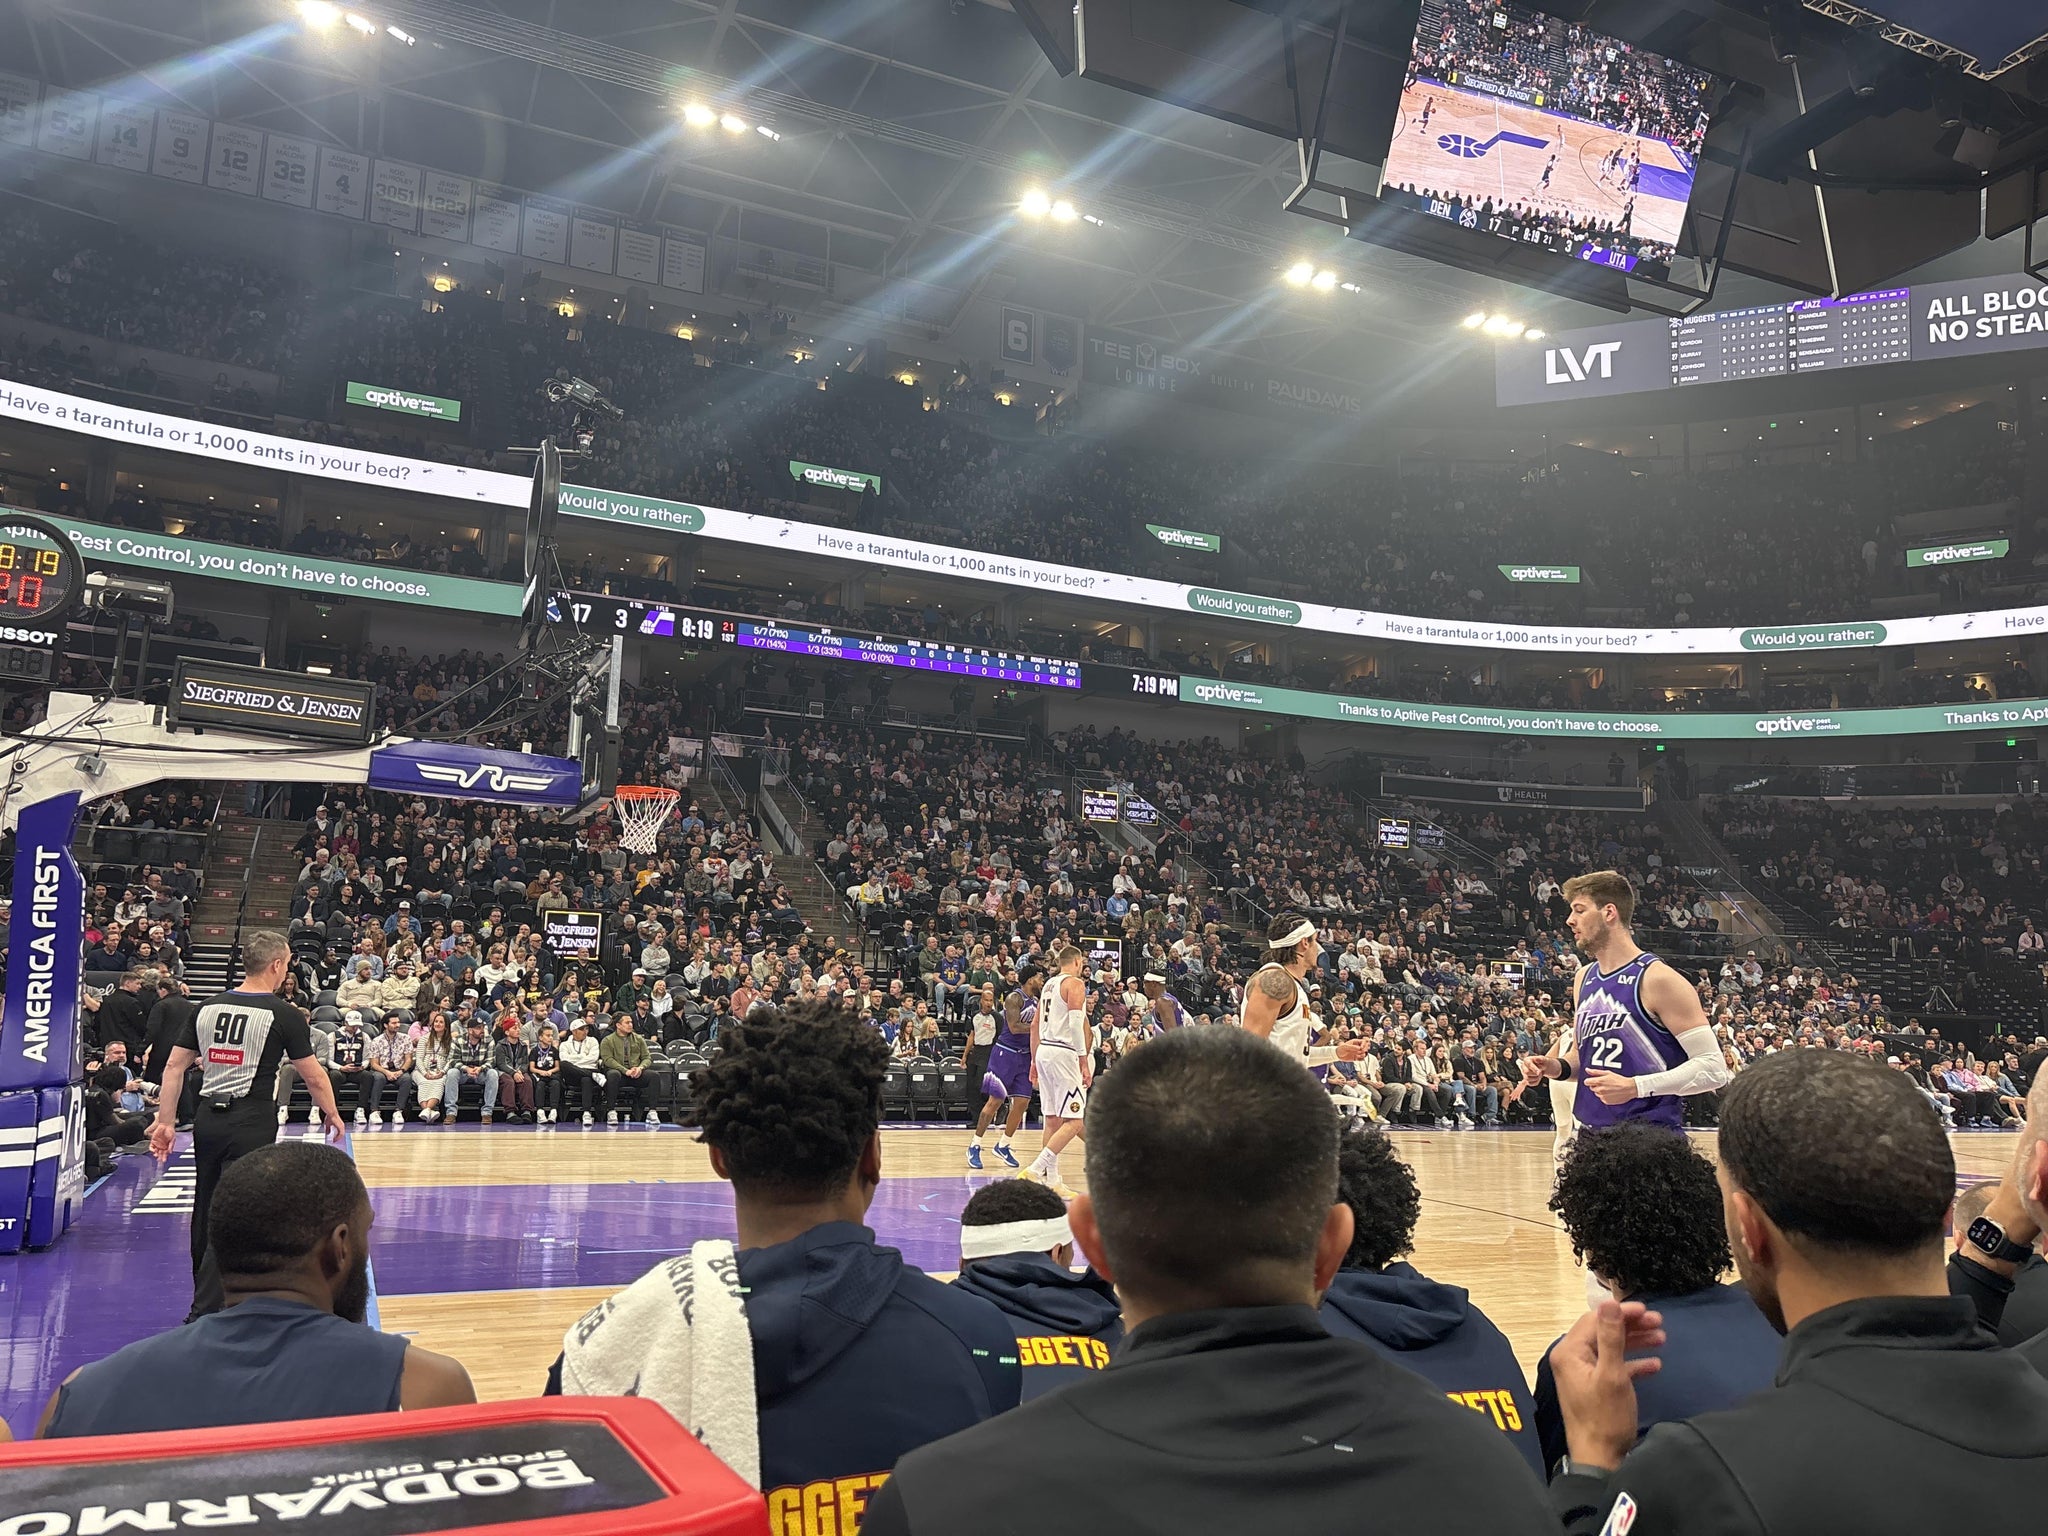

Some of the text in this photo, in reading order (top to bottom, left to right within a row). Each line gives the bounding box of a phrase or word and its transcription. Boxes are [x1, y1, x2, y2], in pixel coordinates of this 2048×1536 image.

[1463, 75, 1530, 101] SIEGFRIED & JENSEN
[51, 111, 87, 135] 53
[112, 124, 139, 148] 14
[172, 138, 190, 158] 9
[221, 148, 248, 171] 12
[273, 160, 306, 184] 32
[336, 175, 351, 194] 4
[427, 194, 468, 216] 1223
[1430, 200, 1627, 269] DEN 17 8:19 21 3 UTA
[1802, 300, 1821, 310] JAZZ
[1927, 297, 1977, 320] ALL
[1684, 313, 1716, 325] NUGGETS
[1929, 320, 1969, 343] NO
[1976, 310, 2048, 338] STEA
[1007, 319, 1029, 352] 6
[1090, 338, 1201, 376] TEE BOX
[1545, 341, 1622, 384] LVT
[1115, 367, 1177, 392] LOUNGE
[366, 390, 419, 410] aptive
[0, 389, 411, 480] Have a tarantula or 1,000 ants in your bed?
[804, 468, 847, 484] aptive
[558, 491, 692, 526] Would you rather:
[1158, 530, 1194, 544] aptive
[0, 543, 60, 576] 8:19
[69, 529, 431, 598] Pest Control, you don't have to choose.
[817, 533, 1095, 589] Have a tarantula or 1,000 ants in your bed?
[1923, 546, 1970, 564] aptive
[1511, 566, 1550, 581] aptive
[572, 603, 628, 628] 17 3
[1196, 593, 1293, 619] Would you rather:
[682, 616, 713, 640] 8:19
[722, 621, 735, 632] 21
[1386, 620, 1638, 648] Have a tarantula or 1,000 ants in your bed?
[2005, 616, 2045, 628] Have
[721, 633, 736, 643] 1ST
[1751, 630, 1875, 645] Would you rather:
[753, 627, 1076, 677] 5/7 (71%) 5/7 (71%) 2/2 (100%) 191 43
[753, 638, 1076, 687] 1/7 (14%) 1/3 (33%) 0/0 (0%) 43 191
[1132, 674, 1178, 696] 7:19 PM
[1195, 684, 1242, 701] aptive
[183, 681, 362, 720] SIEGFRIED & JENSEN
[1338, 701, 1662, 733] Thanks to Aptive Pest Control, you don't have to choose.
[1755, 716, 1813, 735] aptive
[1816, 722, 1841, 730] control
[1944, 709, 2018, 725] Thanks to
[1514, 790, 1547, 800] HEALTH
[1092, 806, 1116, 815] JENSEN
[547, 923, 597, 936] SIEGFRIED
[22, 845, 60, 1063] AMERICA FIRST
[547, 935, 597, 949] & JENSEN
[1617, 974, 1636, 985] LVT
[214, 1012, 249, 1045] 90
[210, 1051, 240, 1061] Emirates
[1591, 1036, 1623, 1069] 22
[1016, 1335, 1110, 1370] GGETS
[311, 1449, 568, 1488] SPORTS DRINK
[0, 1457, 597, 1536] BODYARMO
[767, 1469, 892, 1536] GGE
